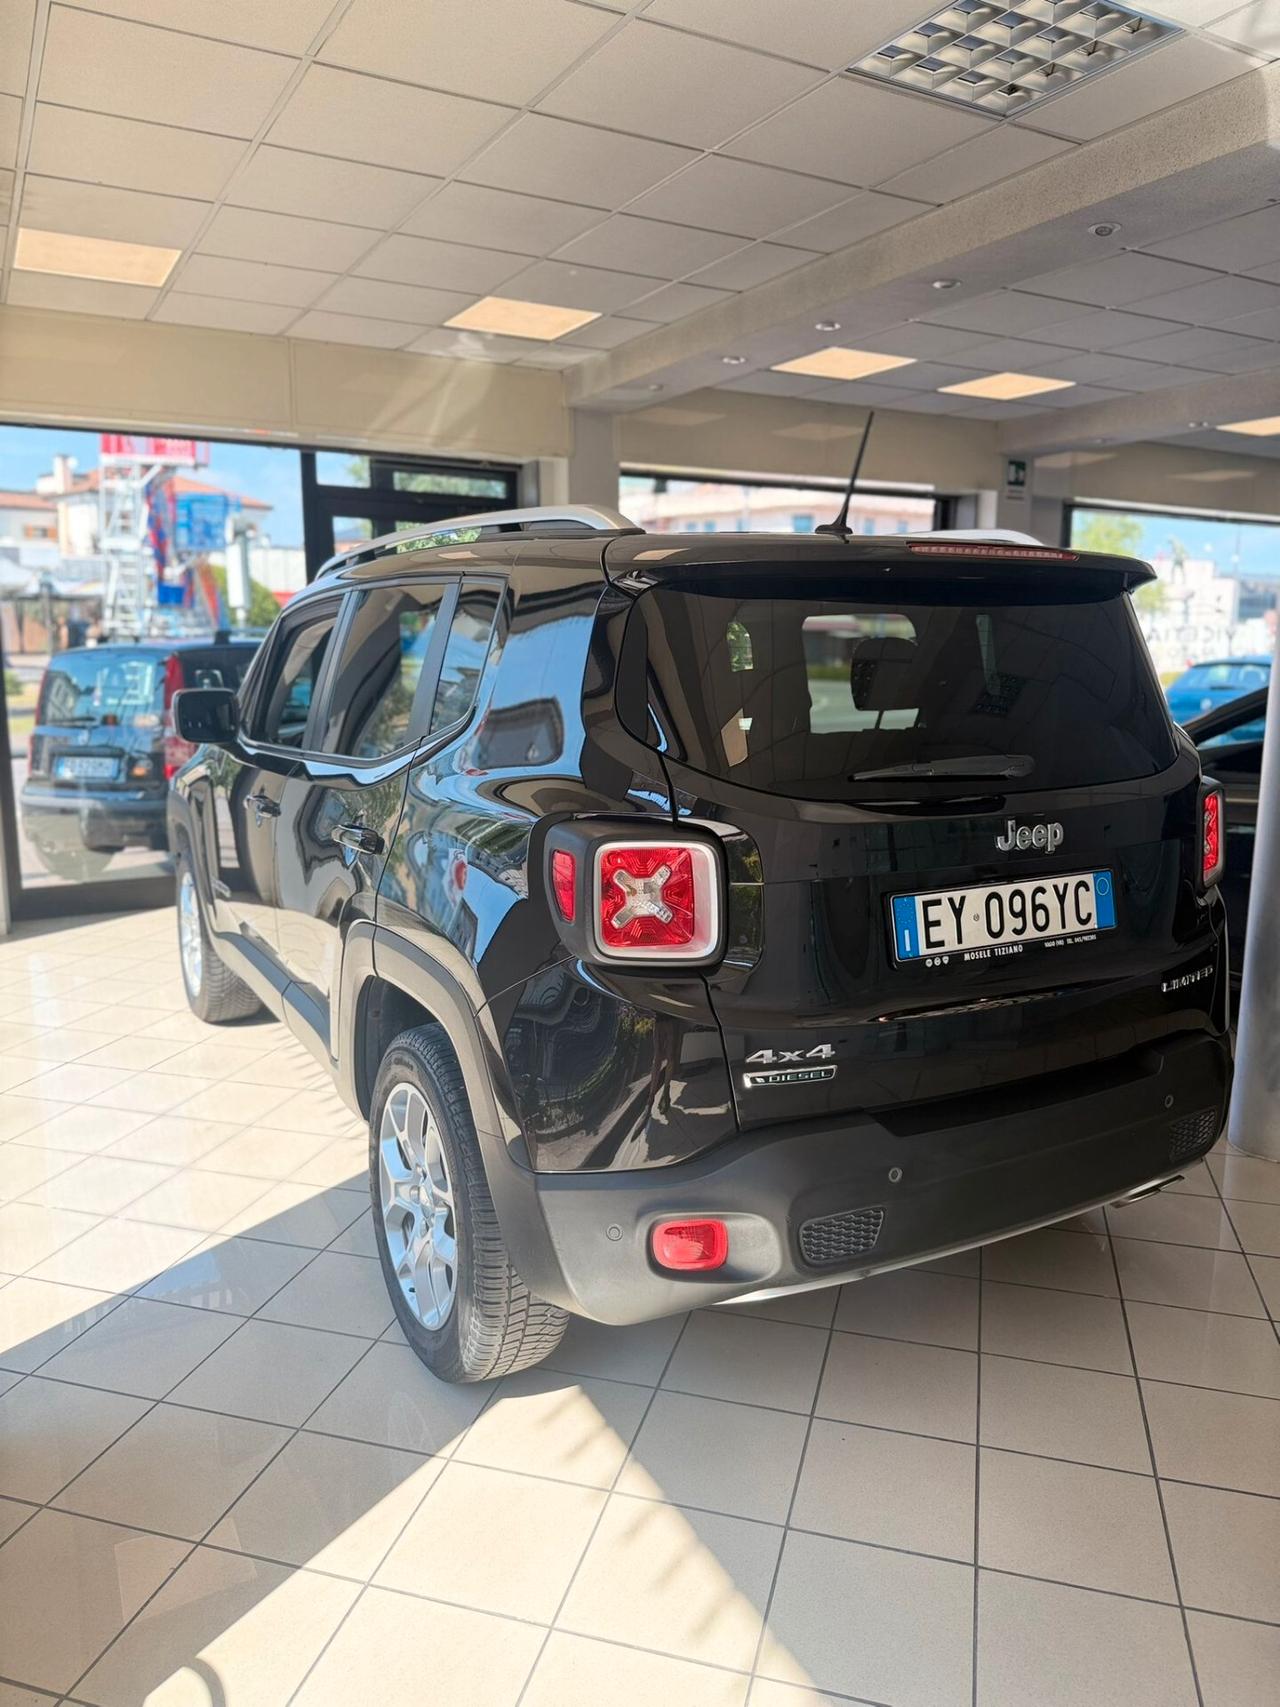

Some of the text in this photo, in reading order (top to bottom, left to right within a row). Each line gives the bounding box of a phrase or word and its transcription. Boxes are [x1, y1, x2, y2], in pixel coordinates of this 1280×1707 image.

[996, 819, 1064, 853] Jeep
[922, 879, 1093, 950] EY 096YC
[963, 944, 1023, 961] MOSELE TIZIANO
[745, 1043, 836, 1064] 4x4
[768, 1070, 832, 1083] DIESEL
